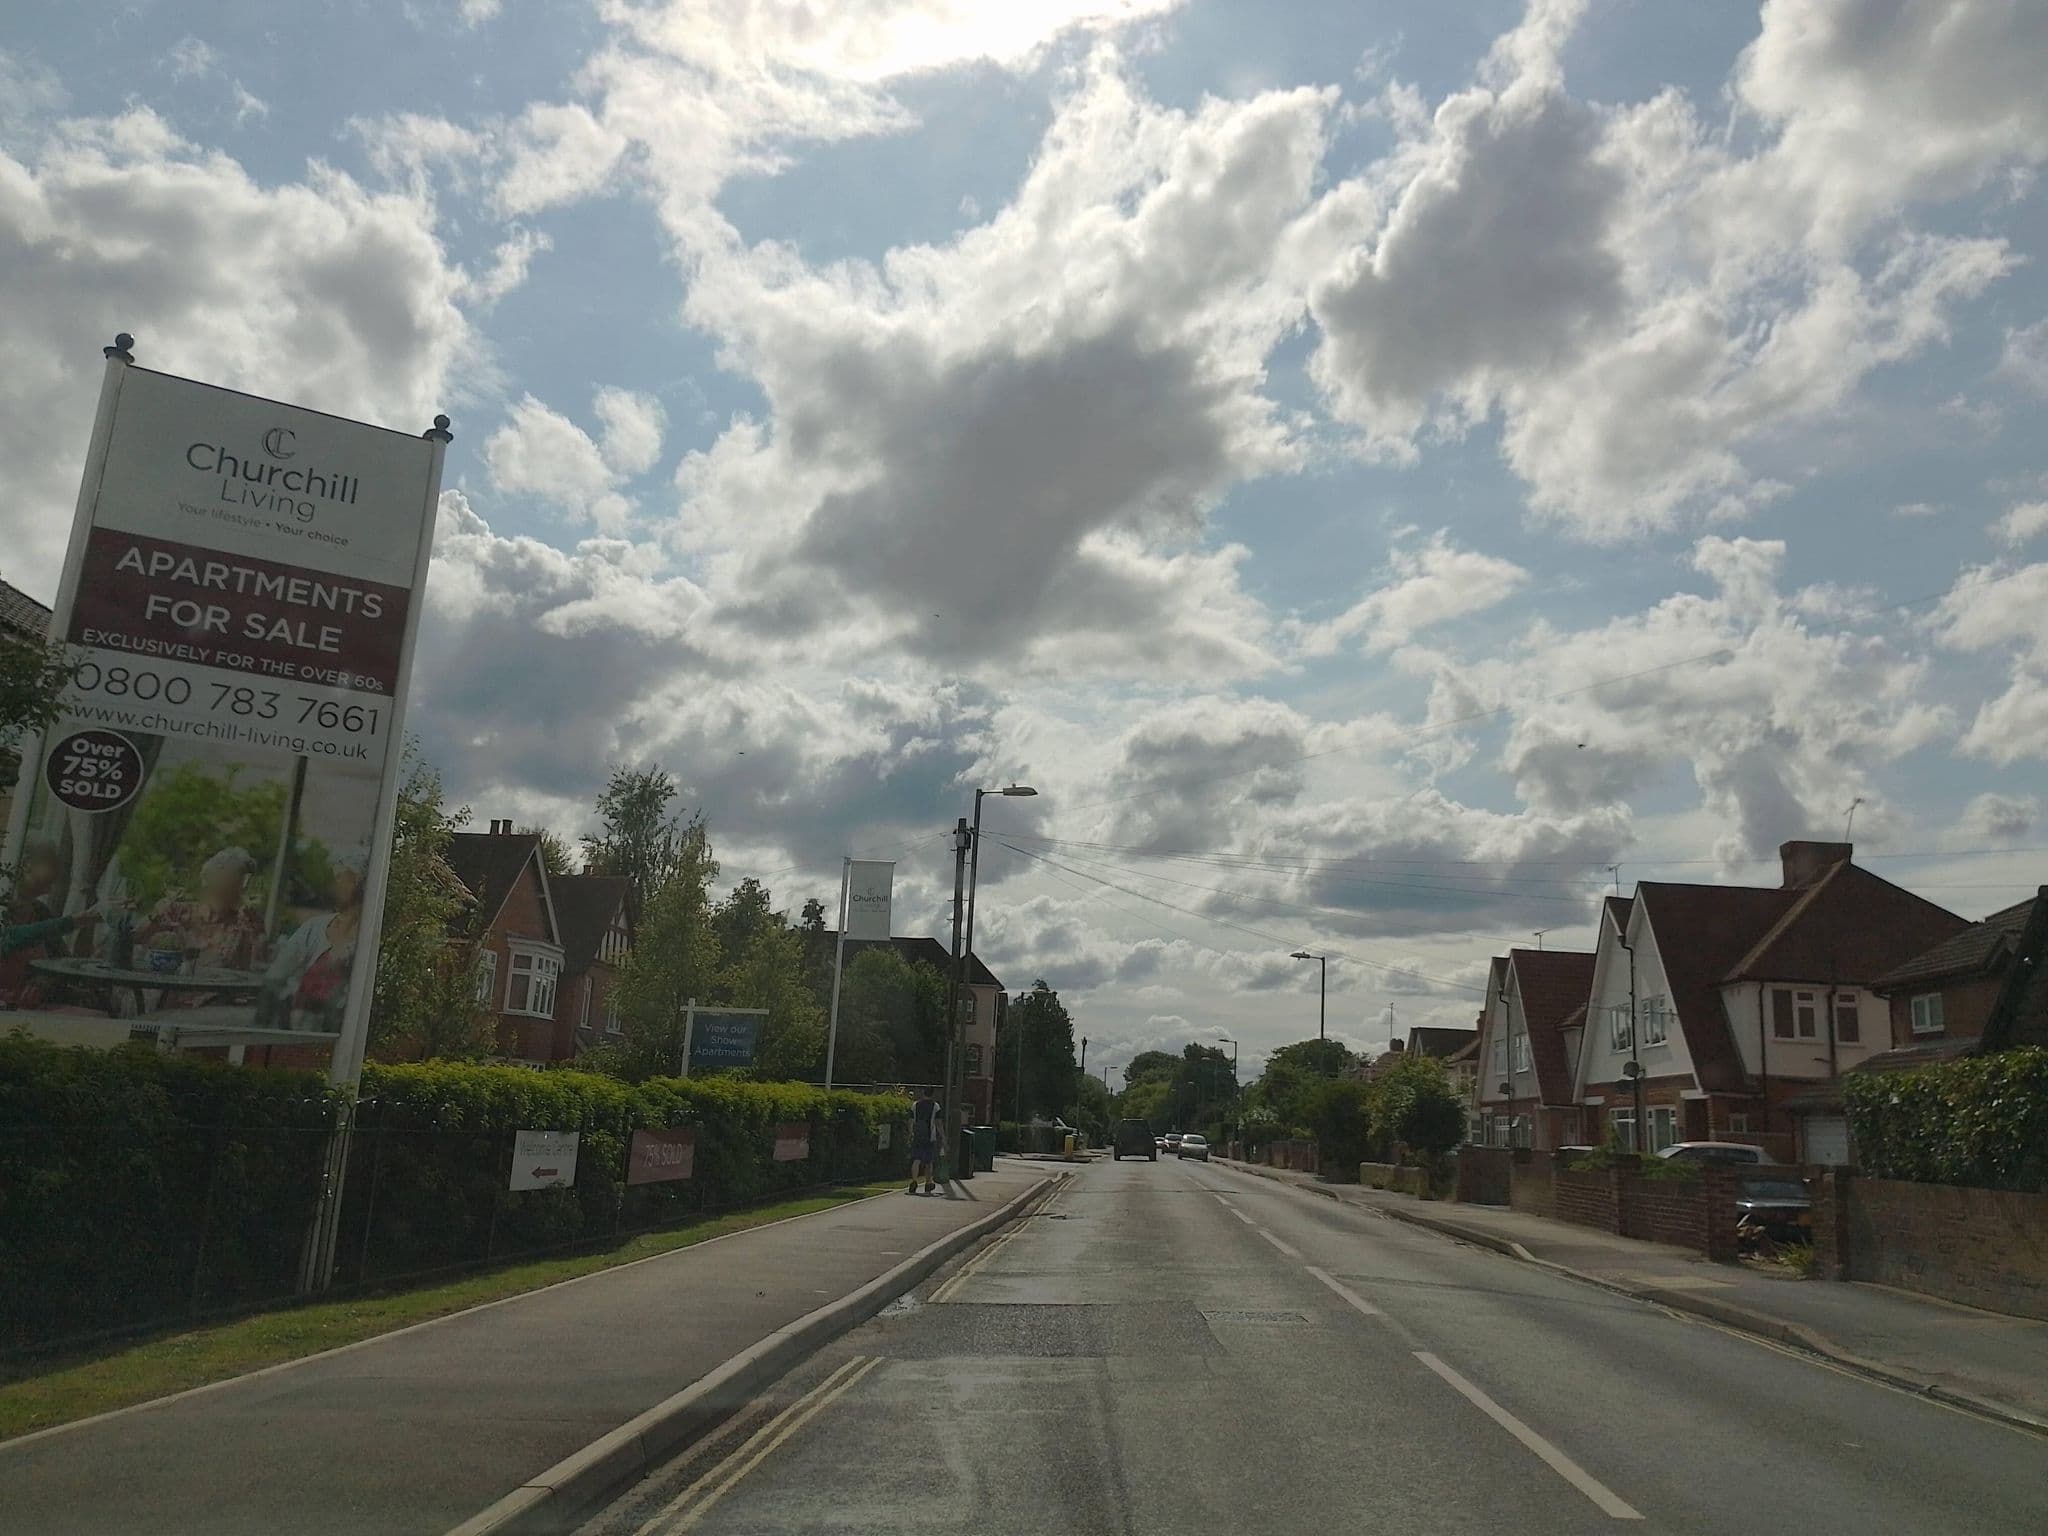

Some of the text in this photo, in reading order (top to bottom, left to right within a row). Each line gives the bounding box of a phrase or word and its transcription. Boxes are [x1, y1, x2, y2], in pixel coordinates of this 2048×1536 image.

[186, 443, 359, 504] Churchill
[221, 479, 316, 523] Living
[177, 502, 349, 546] Your lifestyle Your choice
[115, 547, 384, 619] APARTMENTS
[145, 595, 343, 653] FOR SALE
[82, 628, 383, 691] EXCLUSIVELY FOR THE OVER 60s
[74, 662, 378, 735] 0800 783 7661
[71, 738, 125, 758] Over
[73, 705, 368, 760] www.churchill-living.co.uk
[62, 755, 123, 780] 75%
[59, 779, 122, 799] SOLD
[853, 894, 888, 902] Churchill
[704, 1023, 746, 1034] View our
[711, 1035, 736, 1045] Show
[694, 1044, 751, 1057] Apartments
[660, 1143, 682, 1167] SOLD
